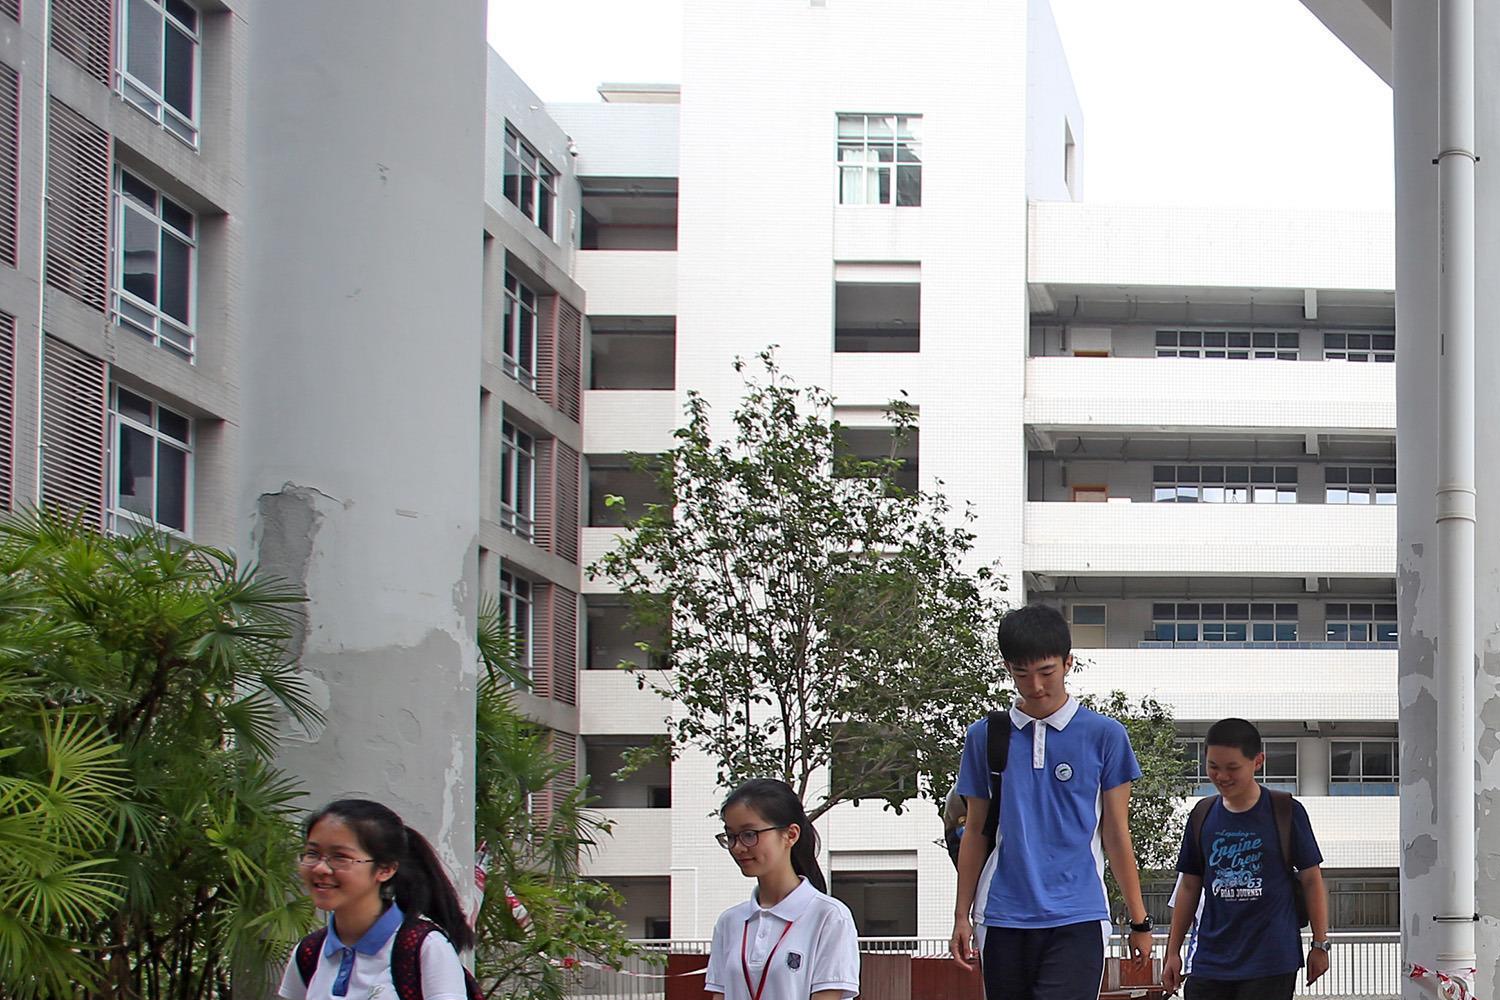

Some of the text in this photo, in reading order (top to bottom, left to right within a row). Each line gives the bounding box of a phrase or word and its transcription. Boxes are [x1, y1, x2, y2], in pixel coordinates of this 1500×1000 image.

[1209, 838, 1263, 867] Engine
[1221, 888, 1263, 898] ROAD JOURNEY
